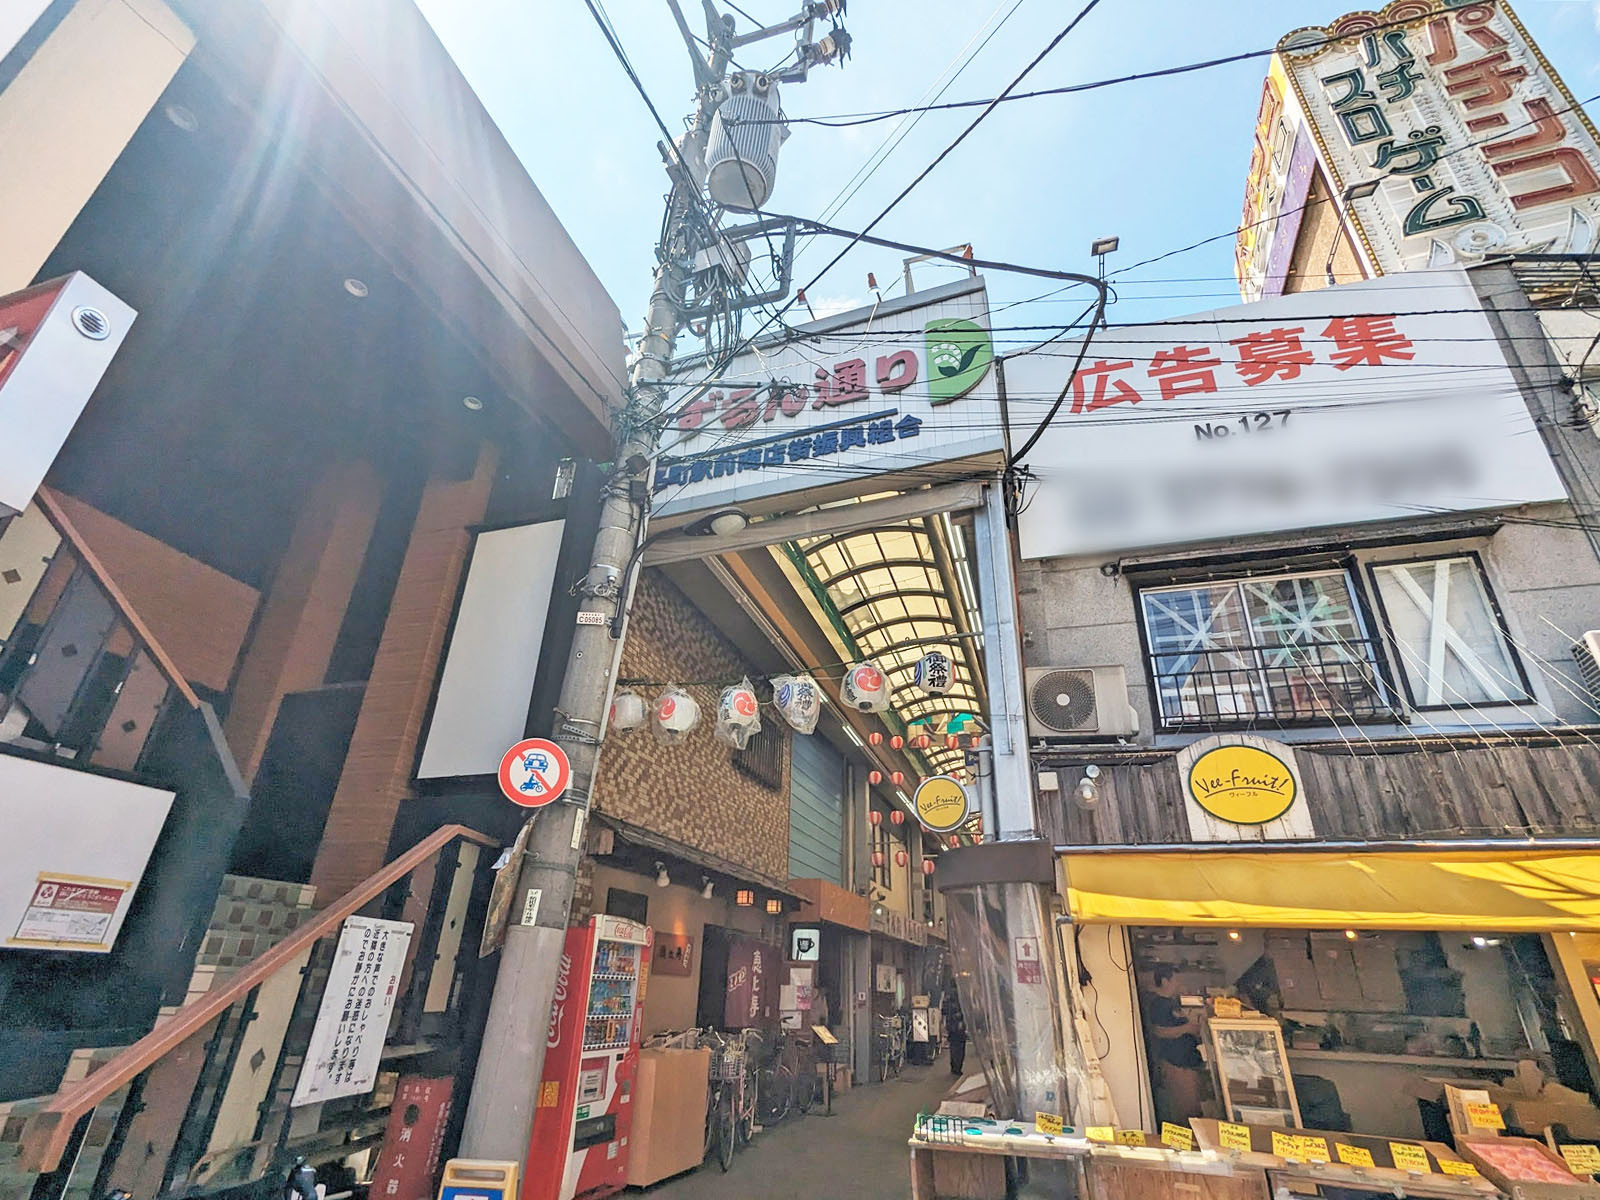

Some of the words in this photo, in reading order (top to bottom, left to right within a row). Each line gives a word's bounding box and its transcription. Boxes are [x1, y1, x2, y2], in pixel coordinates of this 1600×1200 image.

[1425, 3, 1600, 211] パチンコ
[1069, 314, 1416, 415] 広告募集
[1193, 409, 1292, 442] No.127
[1194, 768, 1290, 794] Vee-Fruit!
[386, 1127, 413, 1195] 消火器
